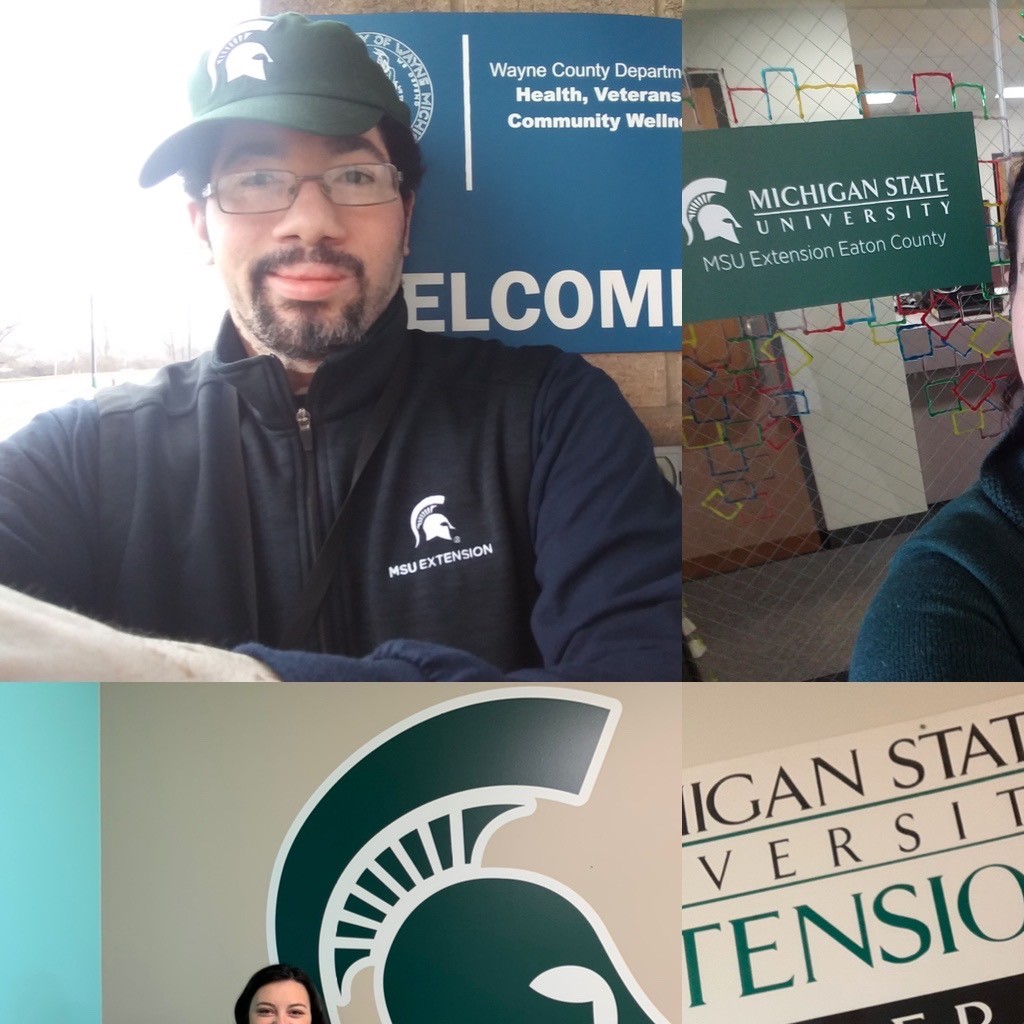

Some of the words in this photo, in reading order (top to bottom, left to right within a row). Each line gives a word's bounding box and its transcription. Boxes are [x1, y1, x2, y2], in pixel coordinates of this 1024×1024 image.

[395, 42, 431, 87] WAYNE
[489, 62, 547, 81] Wayne
[551, 62, 610, 80] County
[515, 87, 589, 105] Health,
[594, 87, 682, 103] Veterans
[507, 113, 621, 132] Community
[626, 113, 682, 129] Welln
[748, 178, 880, 210] MICHIGAN
[885, 172, 948, 196] STATE
[756, 200, 951, 235] UNIVERSITY
[702, 252, 746, 273] MSU
[749, 244, 835, 268] Extension
[838, 236, 887, 257] Eaton
[890, 230, 947, 250] County
[388, 561, 418, 579] MSU
[419, 543, 494, 571] EXTENSION
